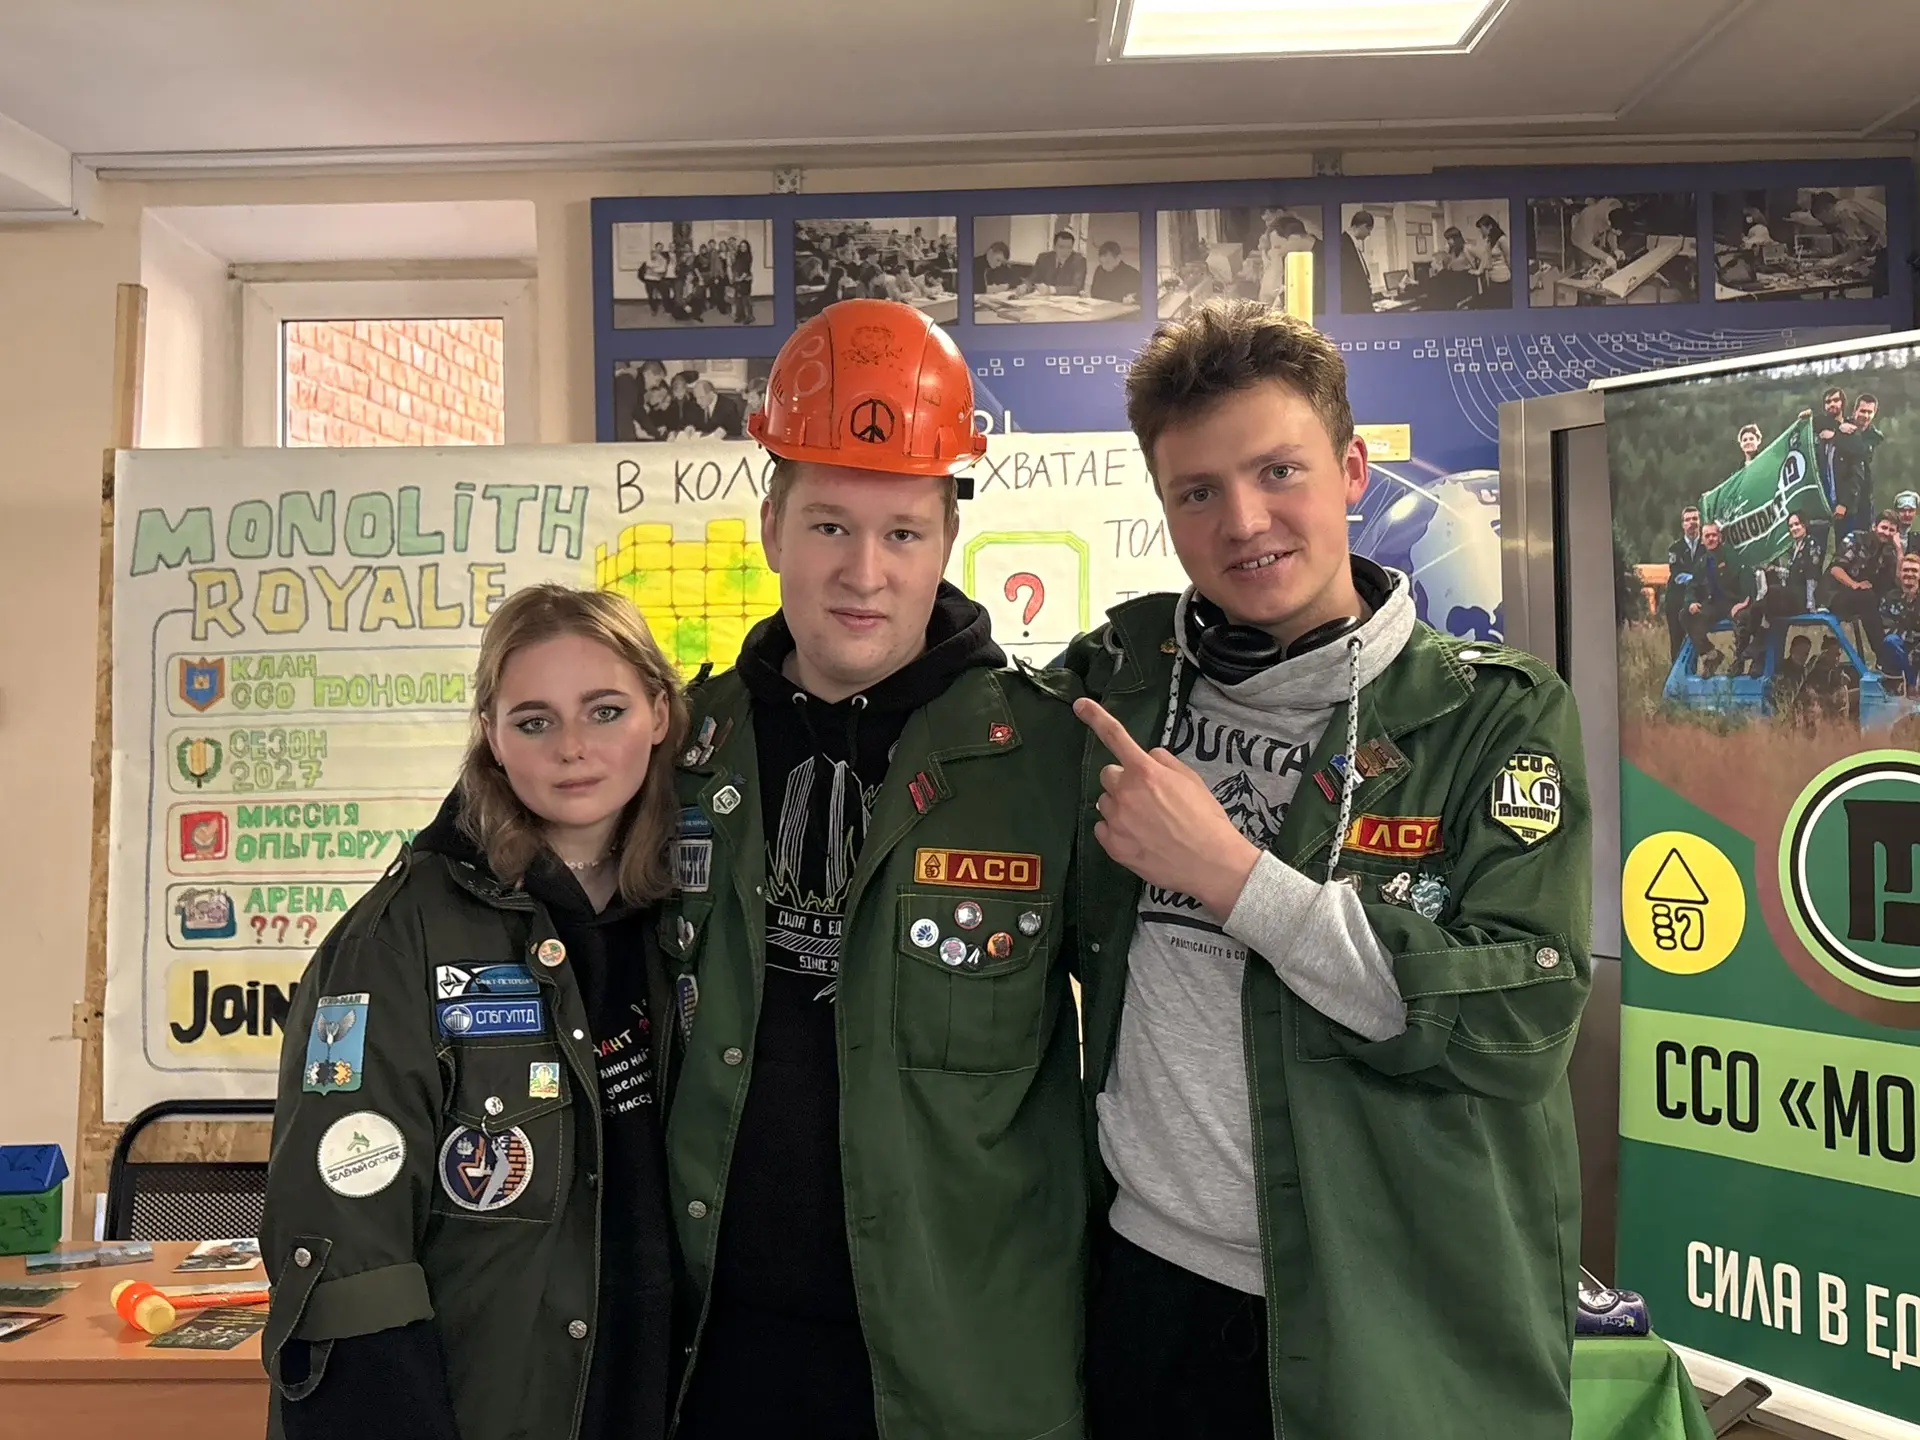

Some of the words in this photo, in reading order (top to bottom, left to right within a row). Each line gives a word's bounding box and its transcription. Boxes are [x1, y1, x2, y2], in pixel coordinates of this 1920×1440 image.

[615, 459, 645, 514] В
[1103, 517, 1177, 559] ТОЛ
[188, 563, 507, 640] ROYALE
[229, 654, 317, 680] КЛАН
[230, 682, 296, 710] ССО
[313, 672, 477, 708] МОНОЛИ
[228, 728, 328, 762] СЕЗОН
[228, 760, 324, 793] 2027
[1505, 755, 1543, 773] ССО
[236, 802, 360, 829] МИССИЯ
[955, 857, 1030, 883] ЛСО
[243, 886, 350, 915] АРЕНА
[1655, 1040, 1761, 1134] ССО
[1686, 1240, 1803, 1336] СИЛА
[1818, 1280, 1849, 1347] В
[1866, 1286, 1920, 1371] ЕД
